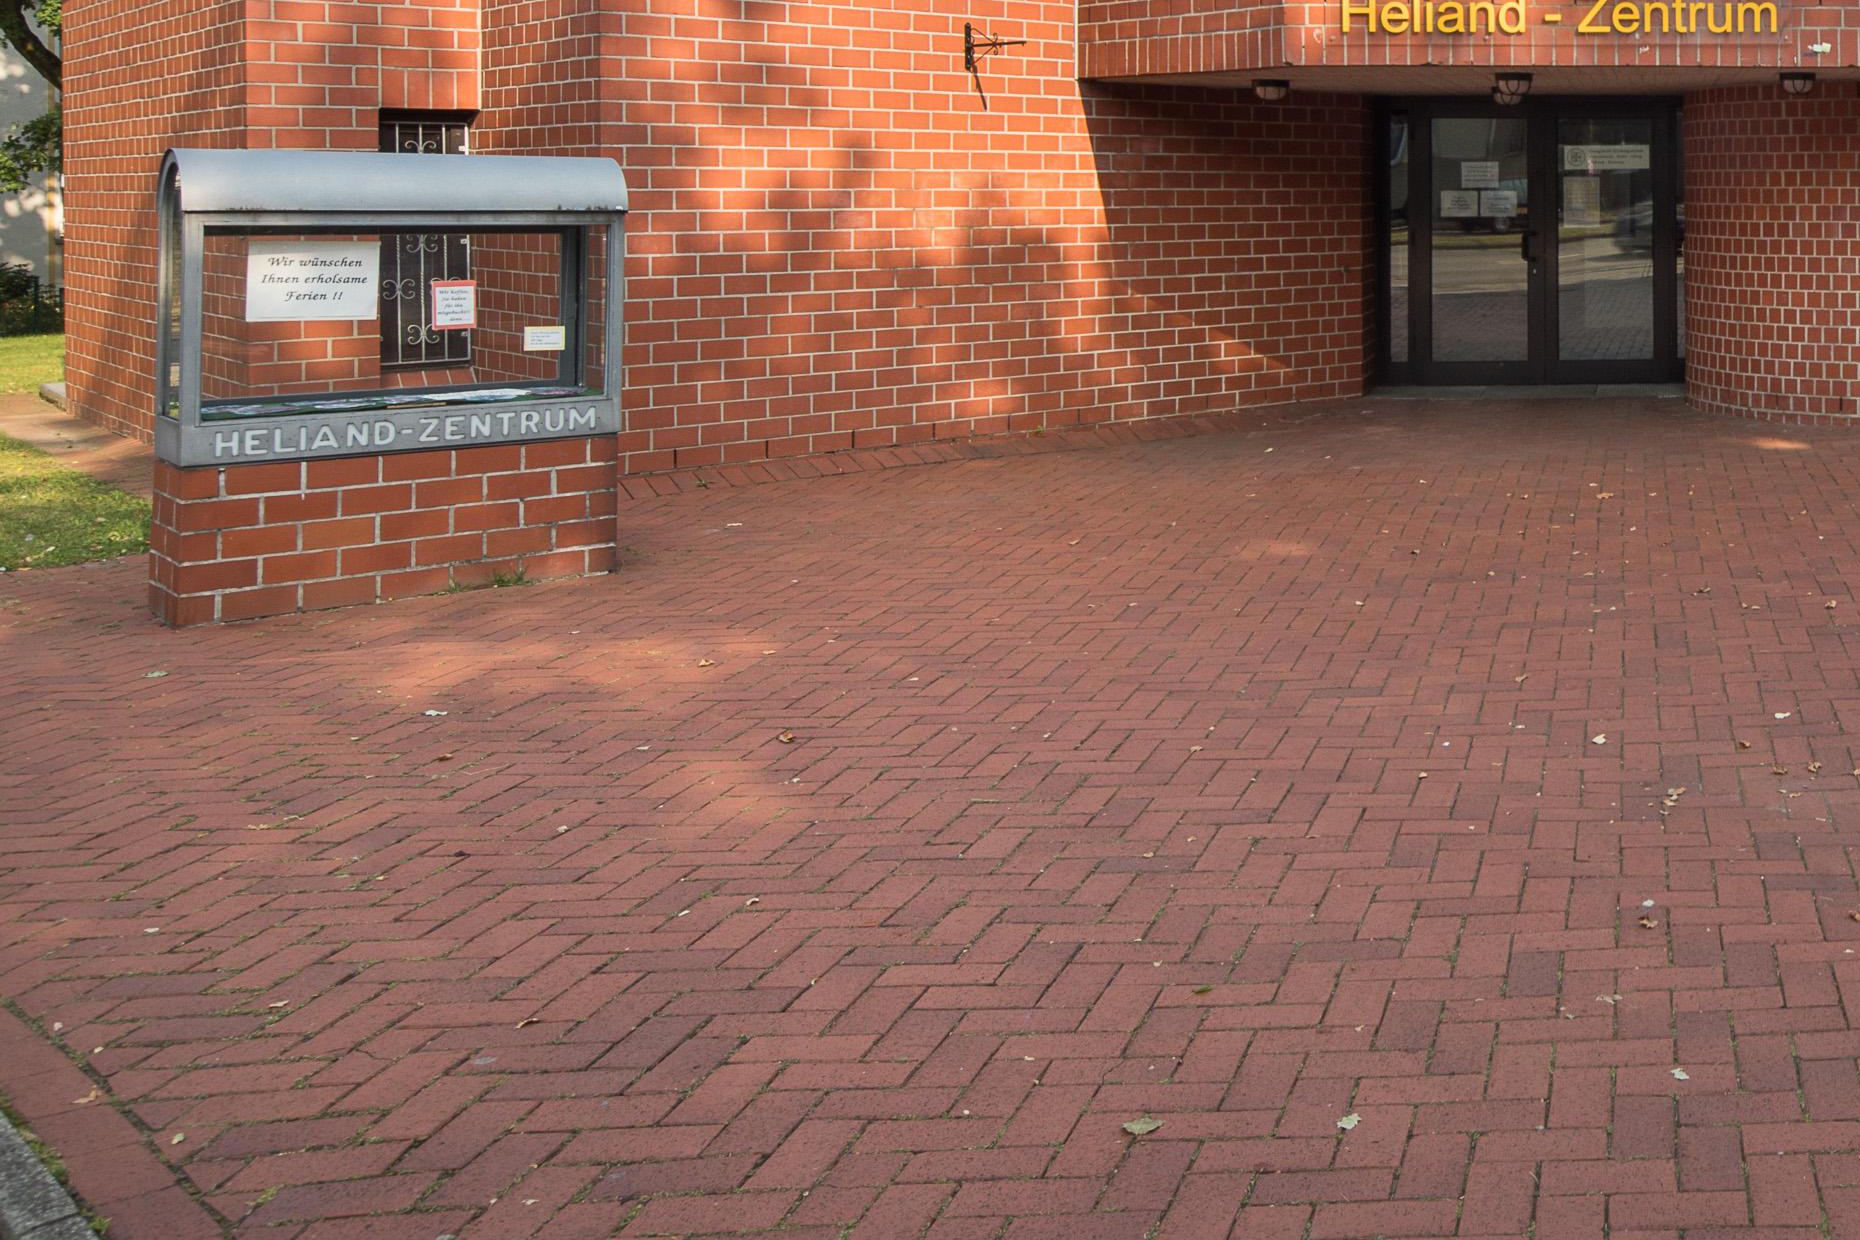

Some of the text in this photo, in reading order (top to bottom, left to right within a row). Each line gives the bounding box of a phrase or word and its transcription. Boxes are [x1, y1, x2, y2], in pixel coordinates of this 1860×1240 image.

[1544, 13, 1562, 22] -
[267, 256, 363, 268] Wir wünschen
[261, 273, 369, 284] Ihnen erholsame
[283, 291, 327, 302] Ferien
[214, 406, 597, 458] HELIAND-ZENTRUM
